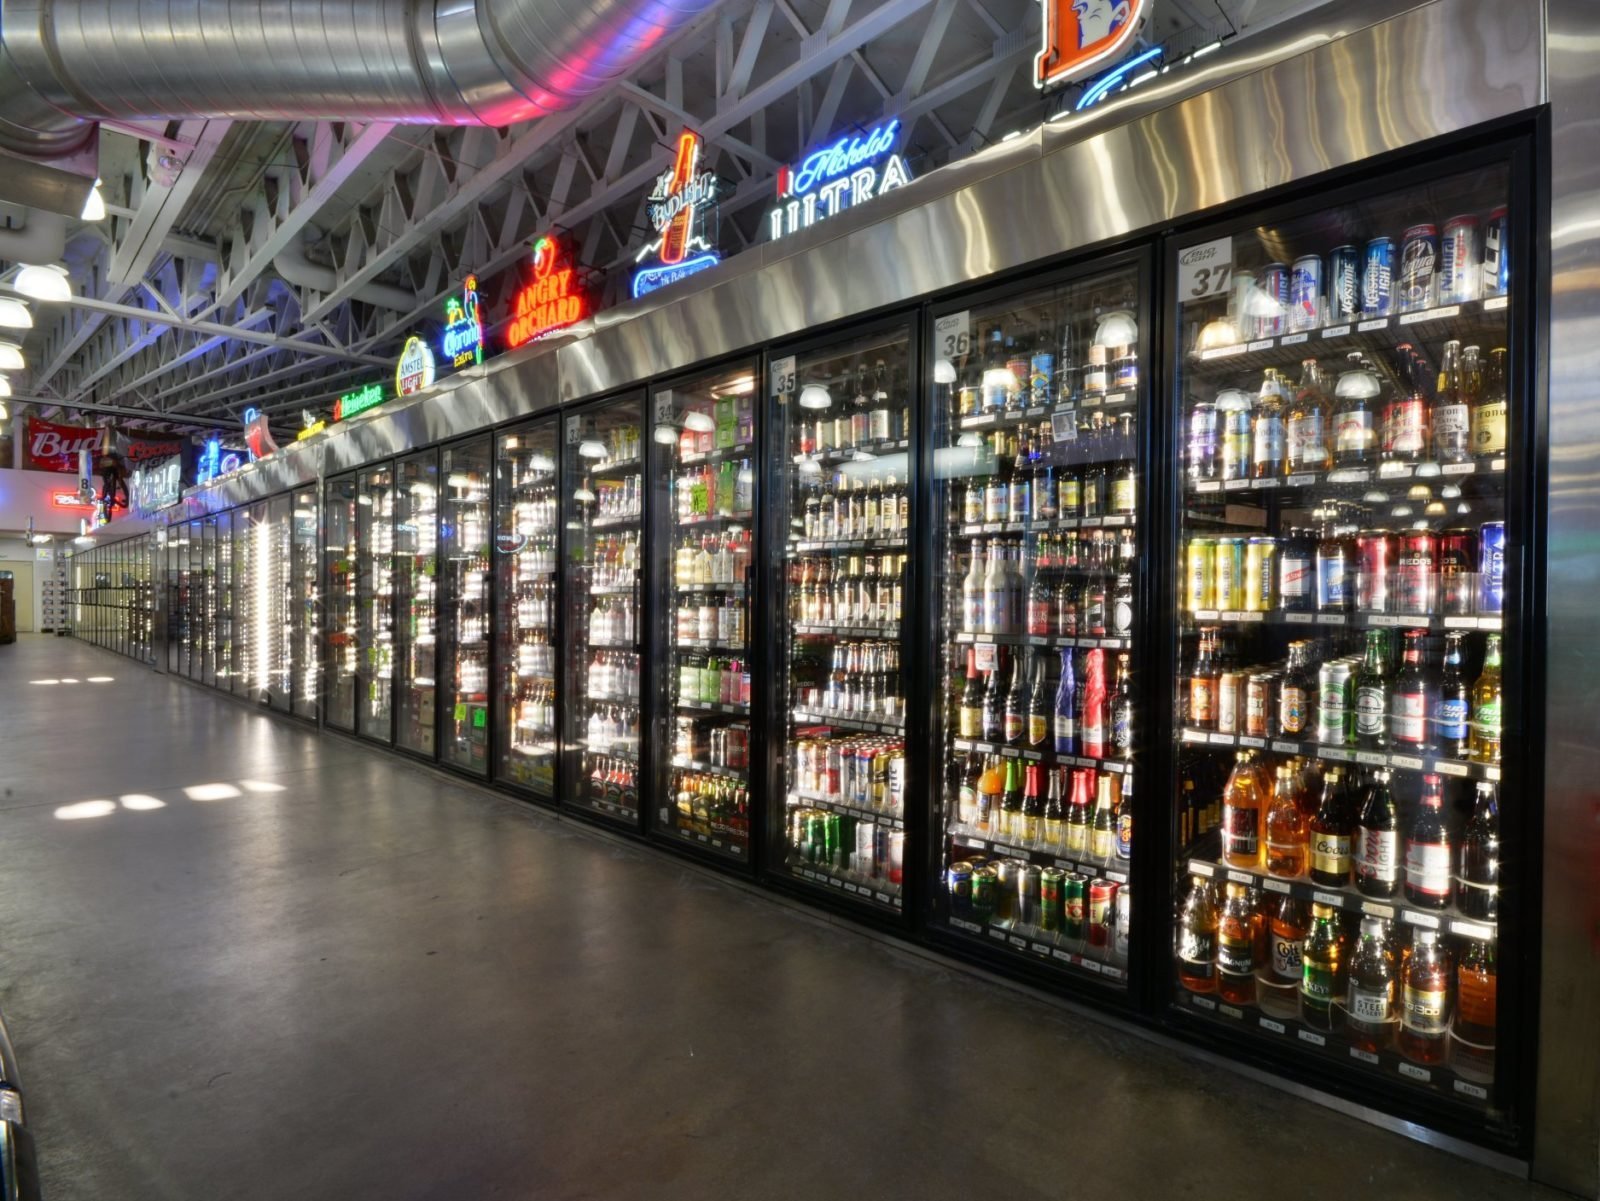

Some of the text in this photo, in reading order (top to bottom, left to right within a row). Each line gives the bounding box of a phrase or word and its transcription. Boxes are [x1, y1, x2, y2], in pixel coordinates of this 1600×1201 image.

[795, 120, 898, 193] Michelob
[651, 172, 712, 231] BUD LIGHT
[771, 154, 908, 241] ULTRA
[517, 270, 571, 315] ANGRY
[1191, 263, 1231, 297] 37
[1379, 265, 1391, 296] LIGHT
[508, 296, 582, 347] ORCHARD
[444, 322, 481, 358] Corona
[944, 331, 969, 357] 36
[400, 357, 424, 376] AMSTEL
[454, 350, 474, 368] Extra
[401, 374, 423, 391] LIGHT
[777, 372, 795, 393] 35
[341, 385, 382, 418] Heineken
[658, 404, 672, 420] 34
[32, 427, 105, 457] Bud
[81, 479, 89, 489] 8
[1378, 840, 1391, 873] LIGHT
[1276, 942, 1300, 958] Colt
[1286, 955, 1301, 967] 45
[1356, 1000, 1385, 1012] STEEL
